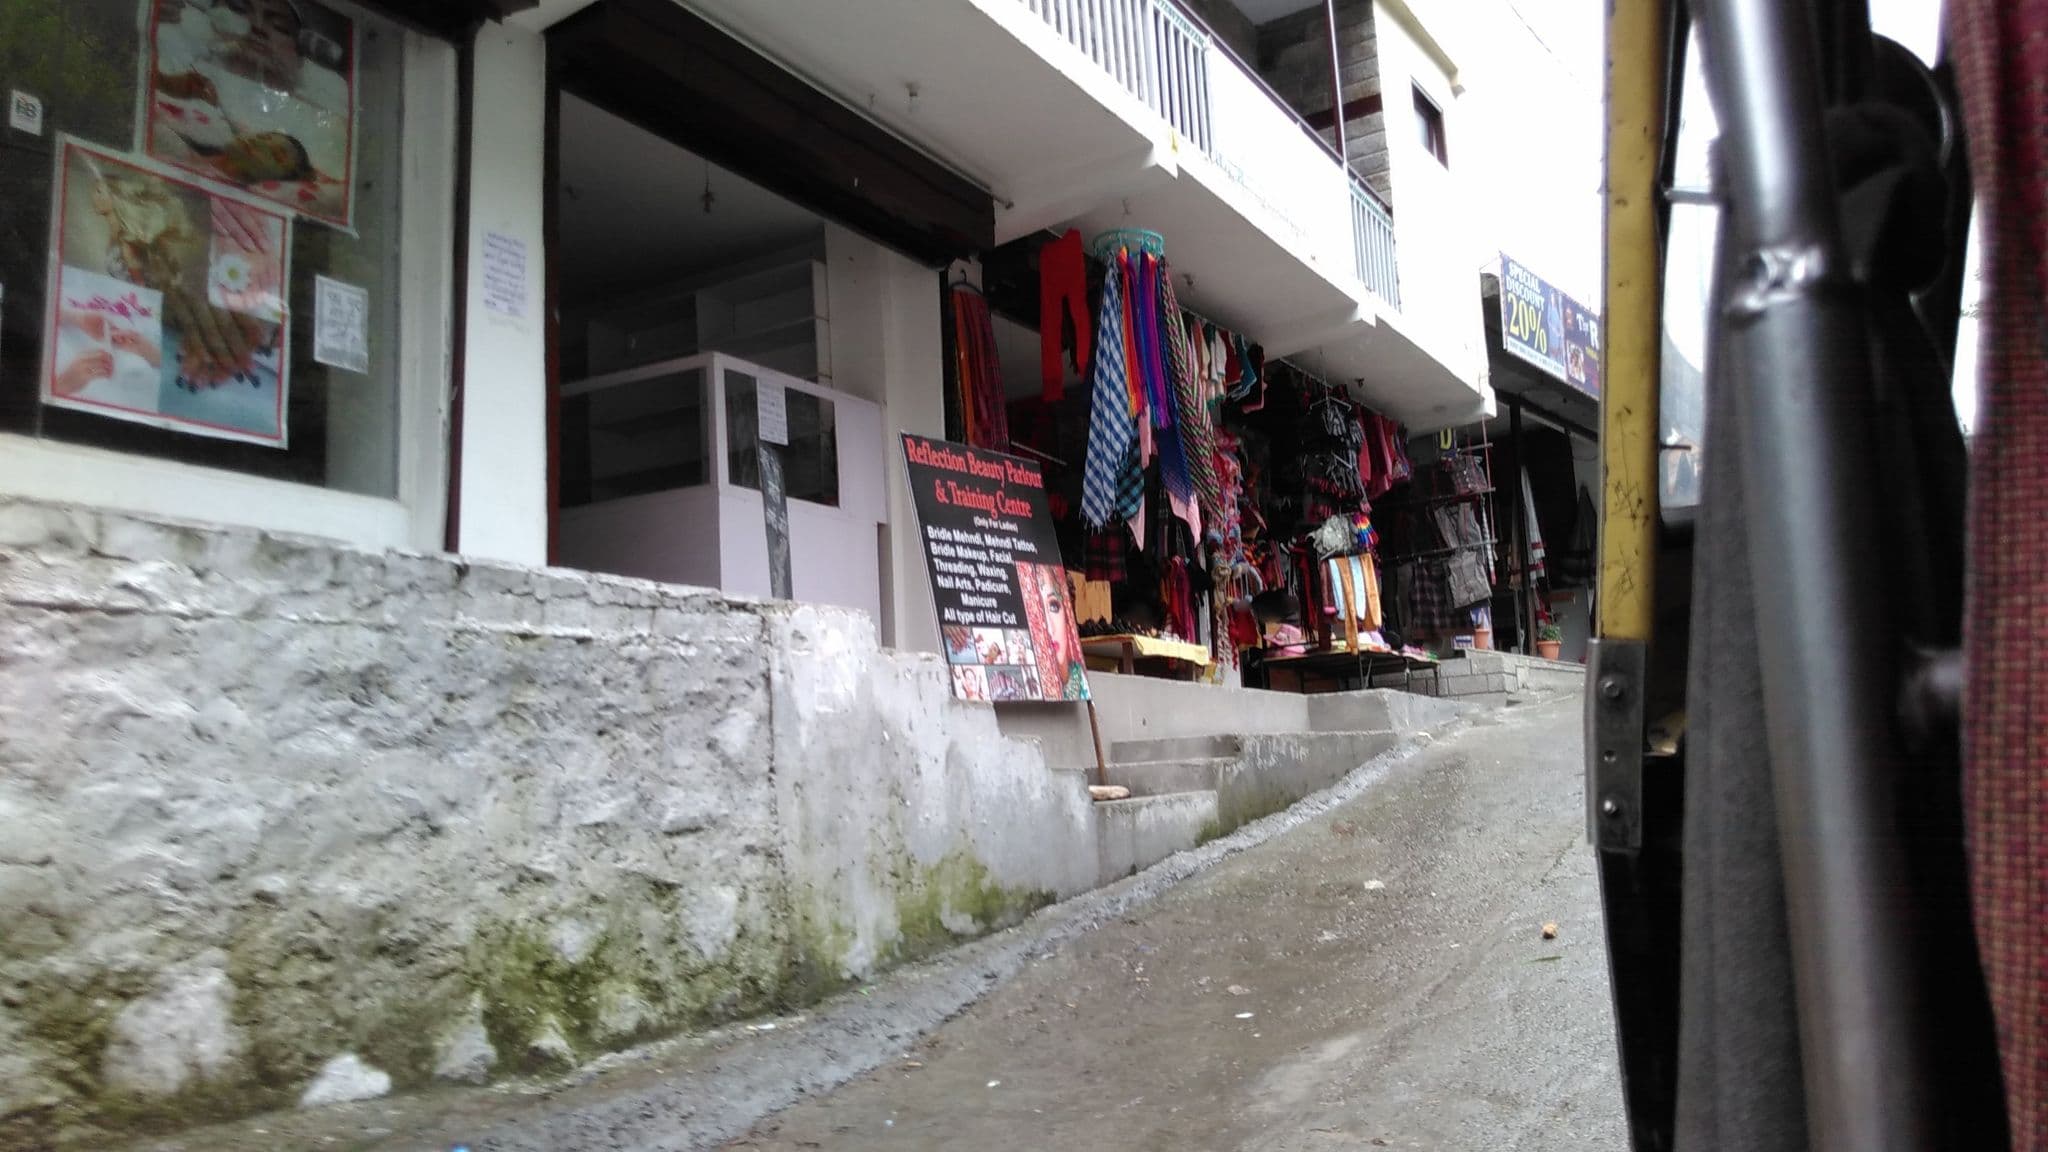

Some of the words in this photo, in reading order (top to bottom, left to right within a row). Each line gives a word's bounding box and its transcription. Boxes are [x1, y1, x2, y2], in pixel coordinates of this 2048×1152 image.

[1508, 260, 1540, 293] SPECIAL
[1505, 275, 1545, 310] DISCOUNT
[1507, 292, 1547, 354] 20%
[905, 437, 967, 473] Reflection
[967, 452, 1005, 488] Beauty
[1004, 460, 1043, 488] Parlour
[934, 479, 949, 504] &
[948, 481, 998, 519] Training
[998, 491, 1033, 519] Centre
[973, 515, 989, 529] (Only
[927, 525, 953, 541] Bridle
[952, 528, 985, 547] Mehndi,
[984, 533, 1012, 550] Mehndi
[1012, 538, 1038, 554] Tattoo,
[930, 541, 956, 557] Bridle
[956, 544, 989, 562] Makeup,
[933, 557, 977, 578] Threading,
[976, 562, 1008, 581] Waxing,
[937, 574, 954, 589] Nail
[955, 576, 975, 592] Arts,
[974, 578, 1012, 596] Padicure,
[960, 592, 998, 608] Manicure
[944, 607, 956, 621] All
[956, 609, 975, 625] type
[975, 609, 985, 623] of
[984, 609, 1001, 624] Hair
[1001, 611, 1017, 625] Cut
